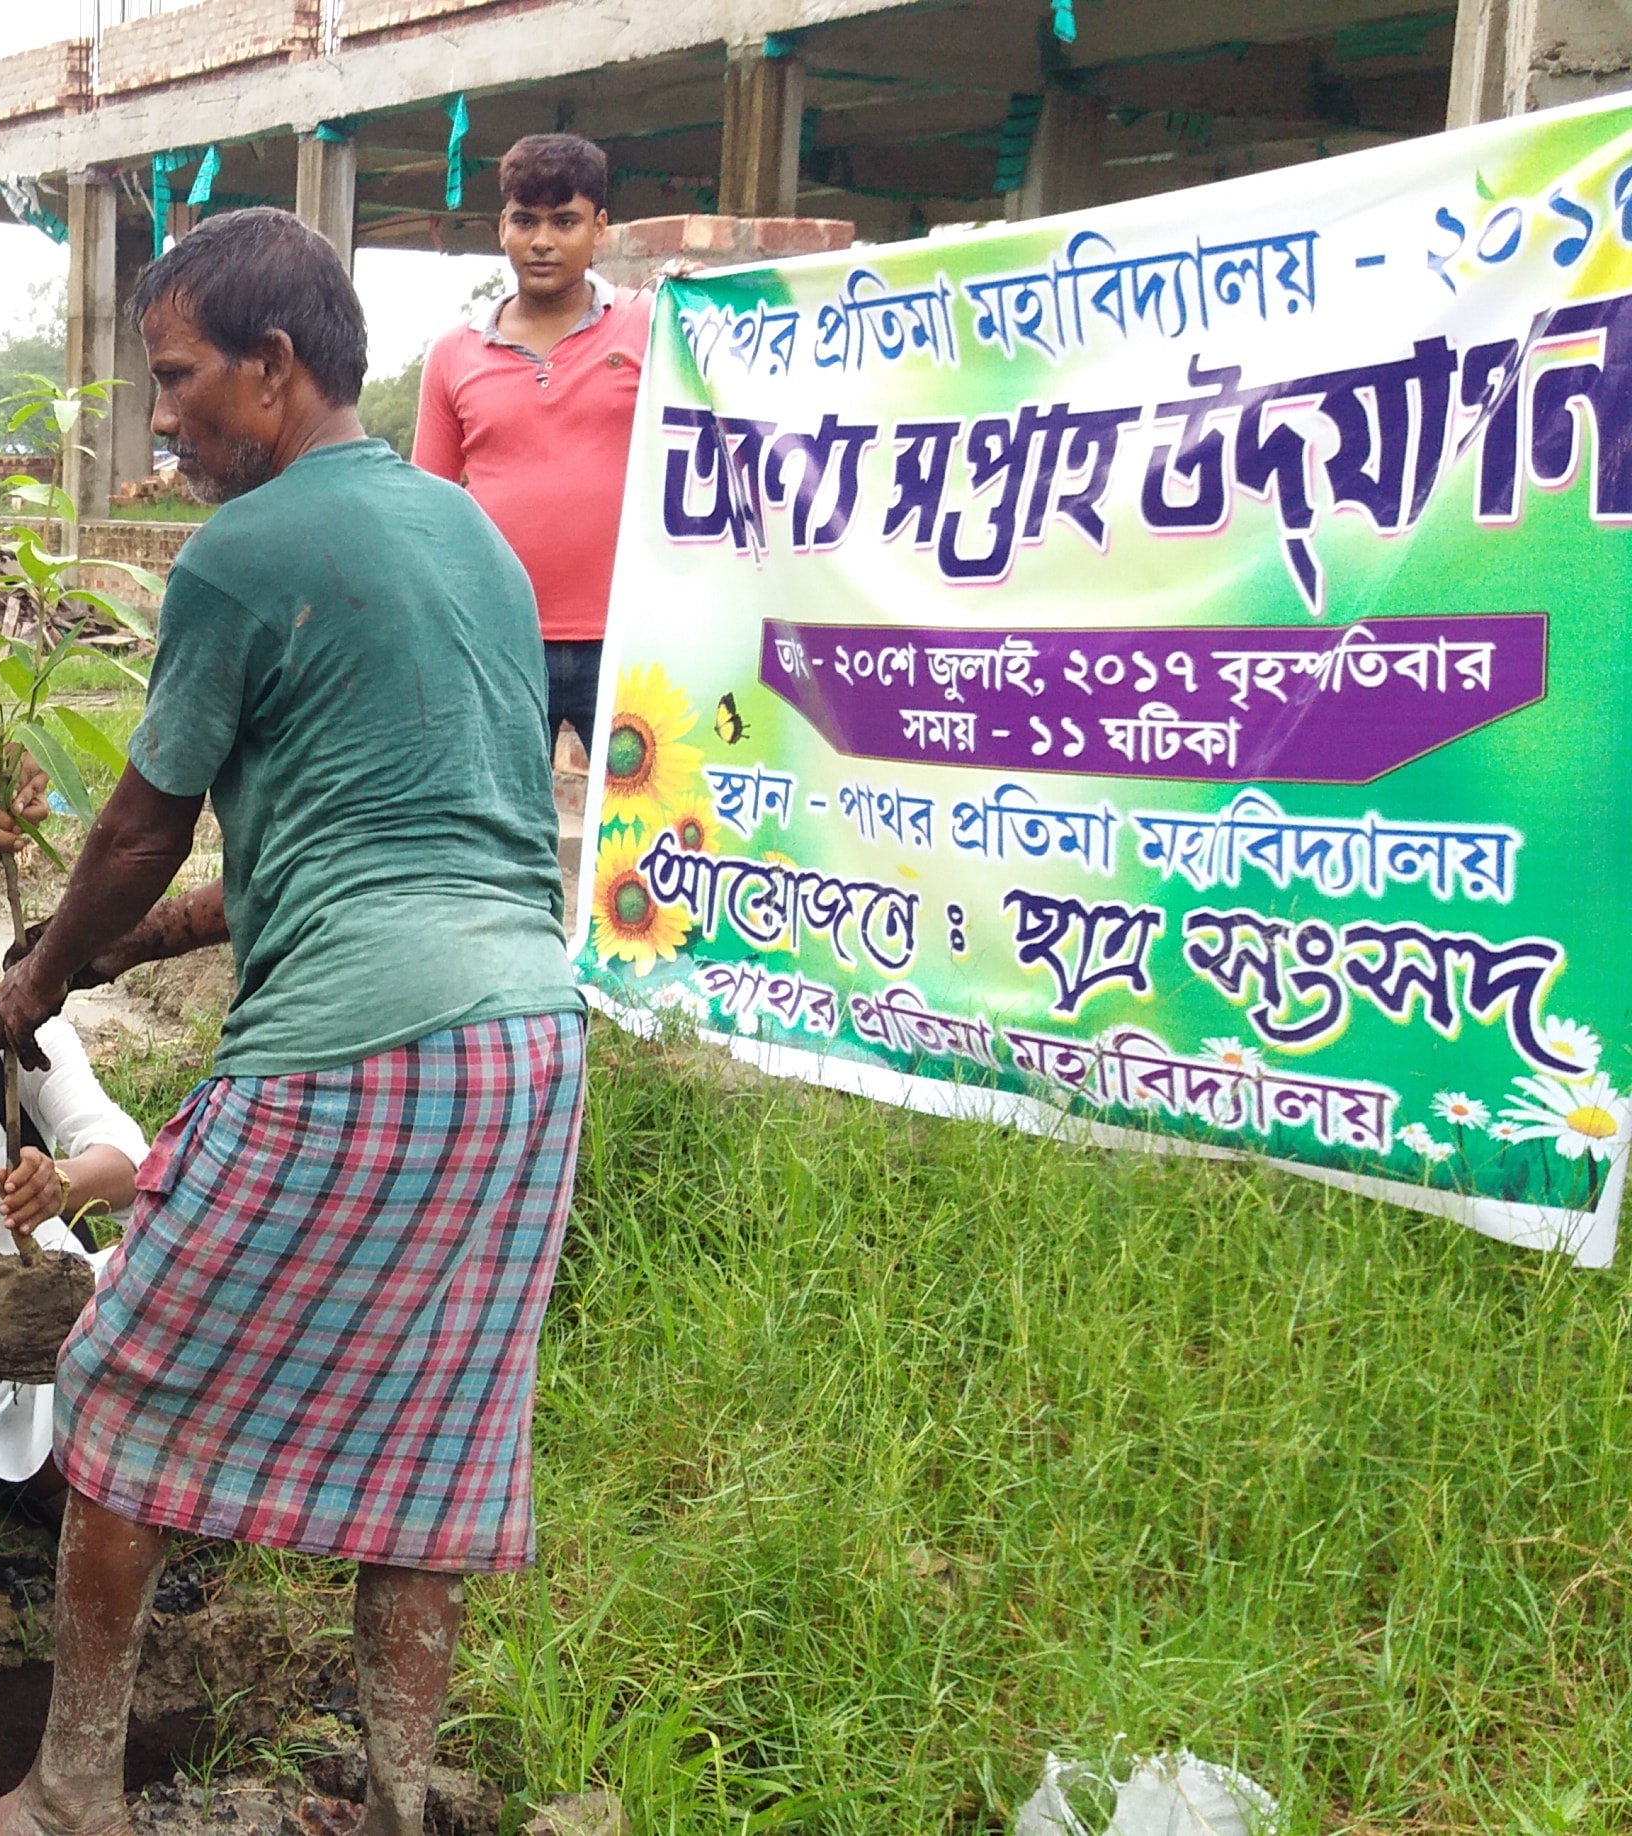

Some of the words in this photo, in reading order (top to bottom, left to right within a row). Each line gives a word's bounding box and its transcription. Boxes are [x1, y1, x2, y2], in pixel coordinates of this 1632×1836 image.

[814, 268, 953, 373] প্রতিমা
[964, 230, 1321, 359] মহাবিদ্যালয়
[882, 402, 1143, 579] সপ্তাহ
[834, 641, 916, 687] ২০শে
[924, 634, 1046, 704] জুলাই,
[1063, 648, 1198, 696] ২০১৭
[1211, 624, 1497, 711] বৃহস্পতিবার
[899, 707, 978, 753] সময়
[1028, 714, 1086, 758] ১১
[1098, 701, 1243, 769] ঘটিকা
[706, 766, 794, 835] স্থান
[838, 783, 936, 849] পাথর
[951, 782, 1118, 870] প্রতিমা
[1136, 795, 1516, 896] মহাবিদ্যালয়
[639, 831, 921, 970] আয়োজনে
[1003, 888, 1161, 1014] ছাত্র
[1186, 908, 1596, 1077] সংসদ
[703, 964, 836, 1035] পাথর
[851, 987, 1000, 1072] প্রতিমা
[1008, 1029, 1394, 1149] মহাবিদ্যালয়
